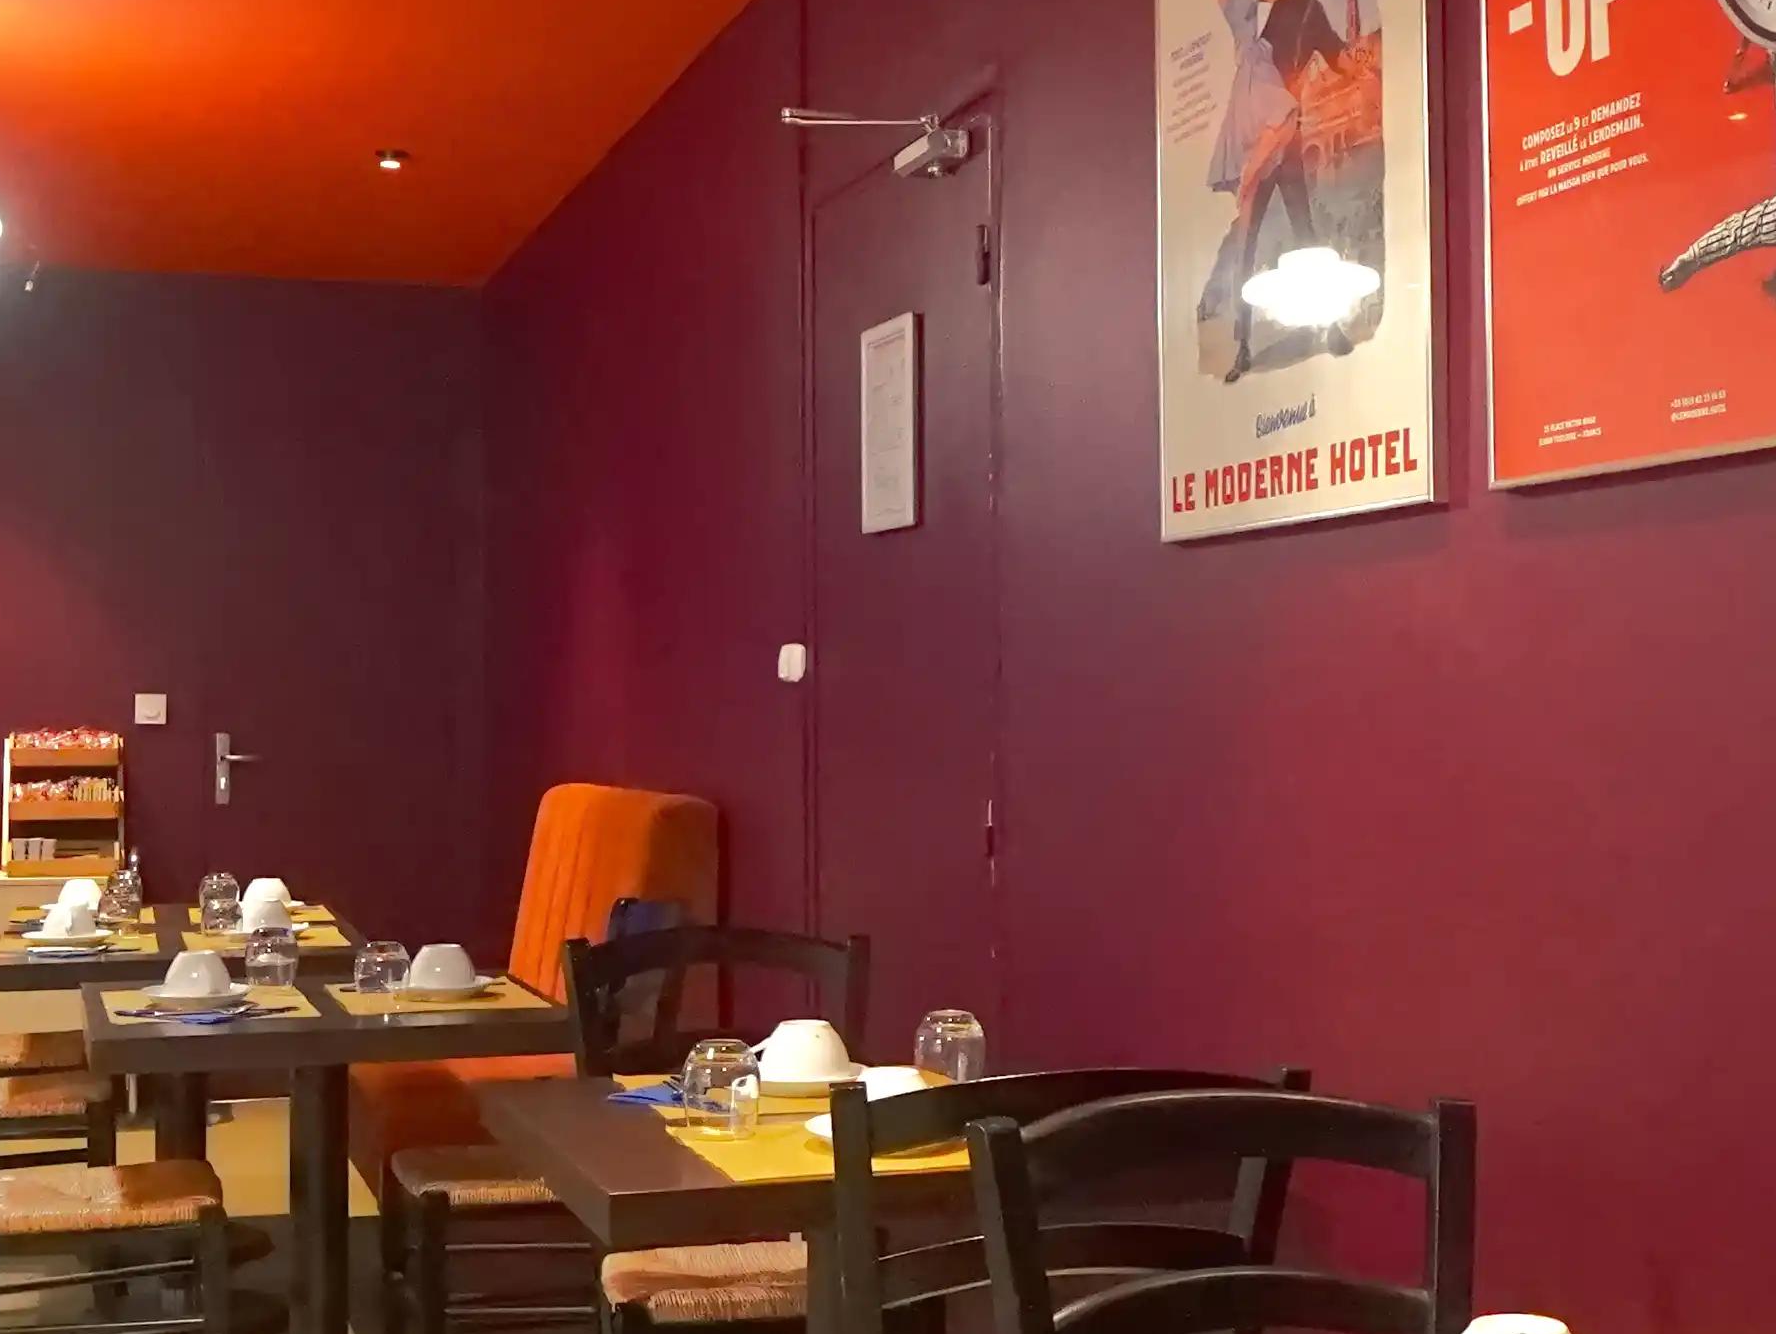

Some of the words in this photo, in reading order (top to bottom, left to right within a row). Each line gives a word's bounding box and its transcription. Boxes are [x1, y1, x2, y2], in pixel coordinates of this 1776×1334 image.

[1522, 121, 1566, 151] COMPOSEZ
[1573, 117, 1580, 131] 9
[1591, 92, 1642, 124] DEMANDEZ
[1172, 474, 1196, 514] LE
[1204, 447, 1318, 509] MODERNE
[1329, 426, 1418, 485] HOTEL
